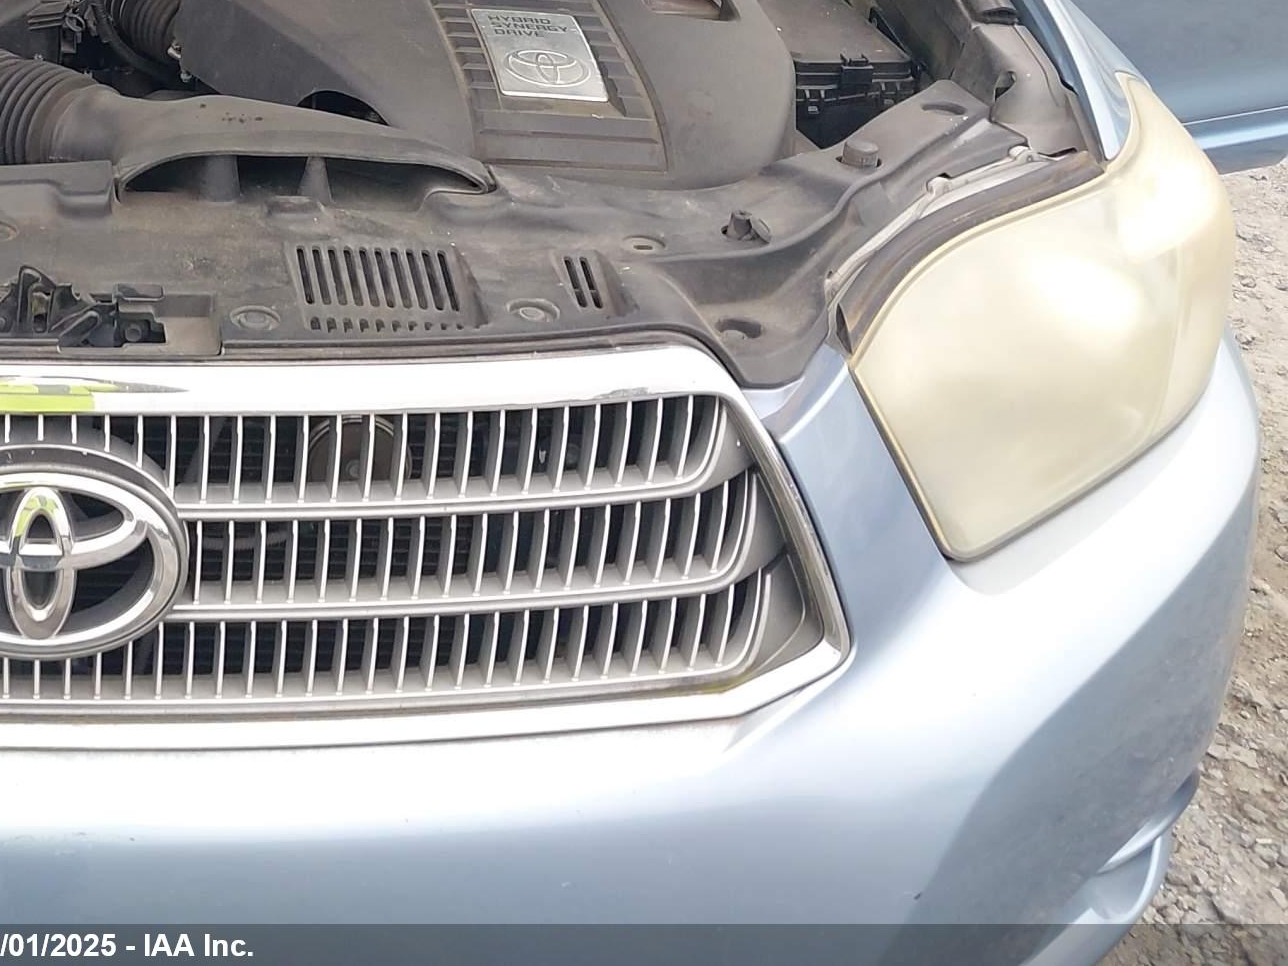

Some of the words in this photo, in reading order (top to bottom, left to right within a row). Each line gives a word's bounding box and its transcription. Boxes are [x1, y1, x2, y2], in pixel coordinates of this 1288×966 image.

[488, 15, 551, 25] HYBRID
[490, 22, 568, 32] SYNERGY
[493, 28, 545, 38] DRIVE
